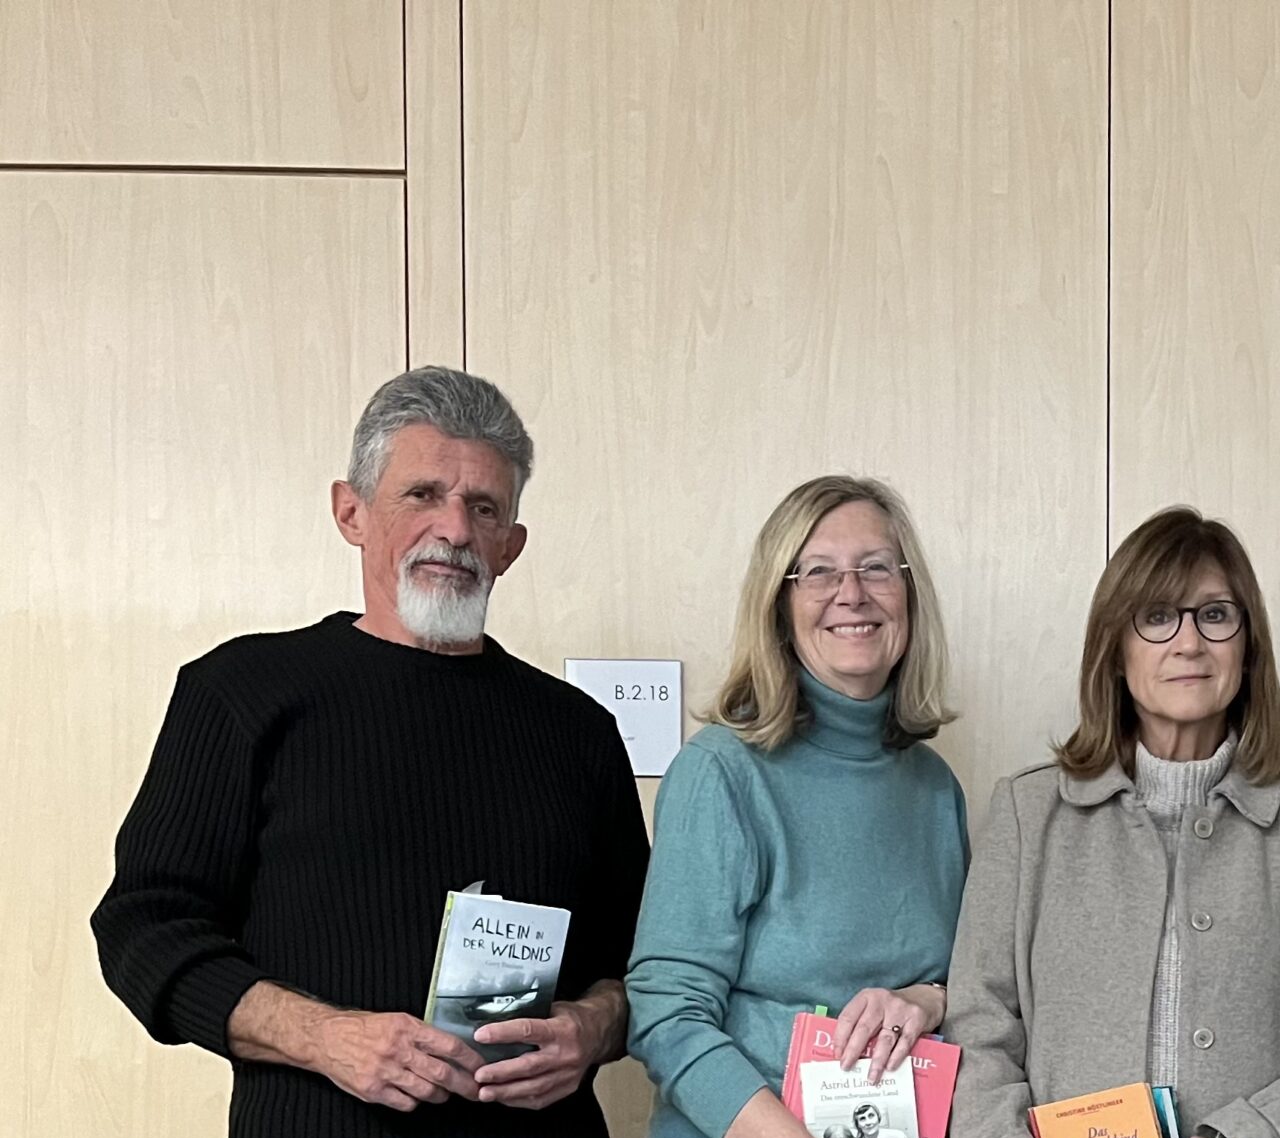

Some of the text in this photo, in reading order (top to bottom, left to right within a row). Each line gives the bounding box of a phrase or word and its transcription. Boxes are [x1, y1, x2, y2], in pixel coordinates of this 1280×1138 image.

[614, 684, 669, 701] B.2.18
[472, 917, 544, 940] ALLEIN IN
[463, 938, 553, 962] DER WILDNIS
[820, 1078, 850, 1091] Astrid
